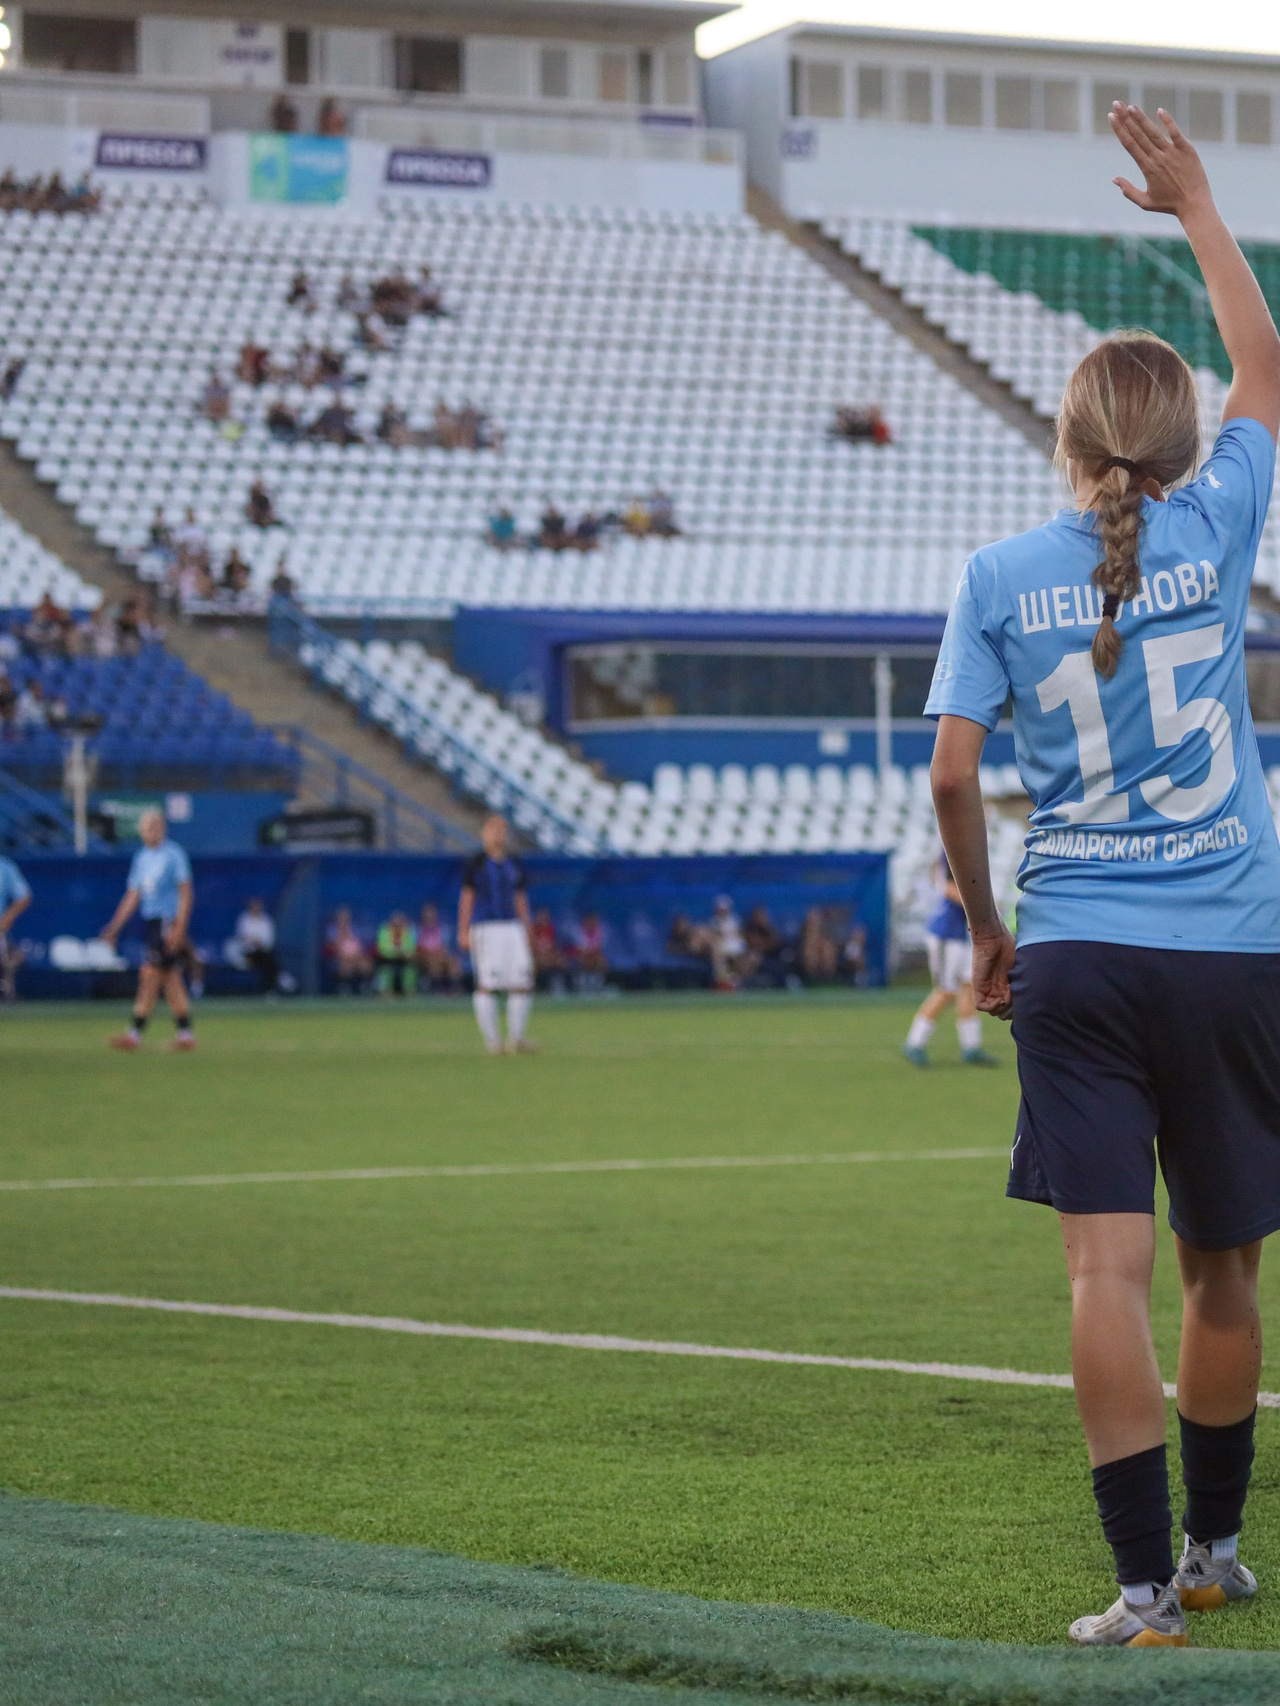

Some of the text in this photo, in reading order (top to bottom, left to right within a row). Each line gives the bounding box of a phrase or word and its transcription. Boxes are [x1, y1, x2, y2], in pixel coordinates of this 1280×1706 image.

[102, 139, 199, 168] ПРЕССА
[392, 155, 487, 184] ПРЕССА
[1035, 622, 1237, 823] 15
[1162, 815, 1249, 862] ОБЛАСТЬ
